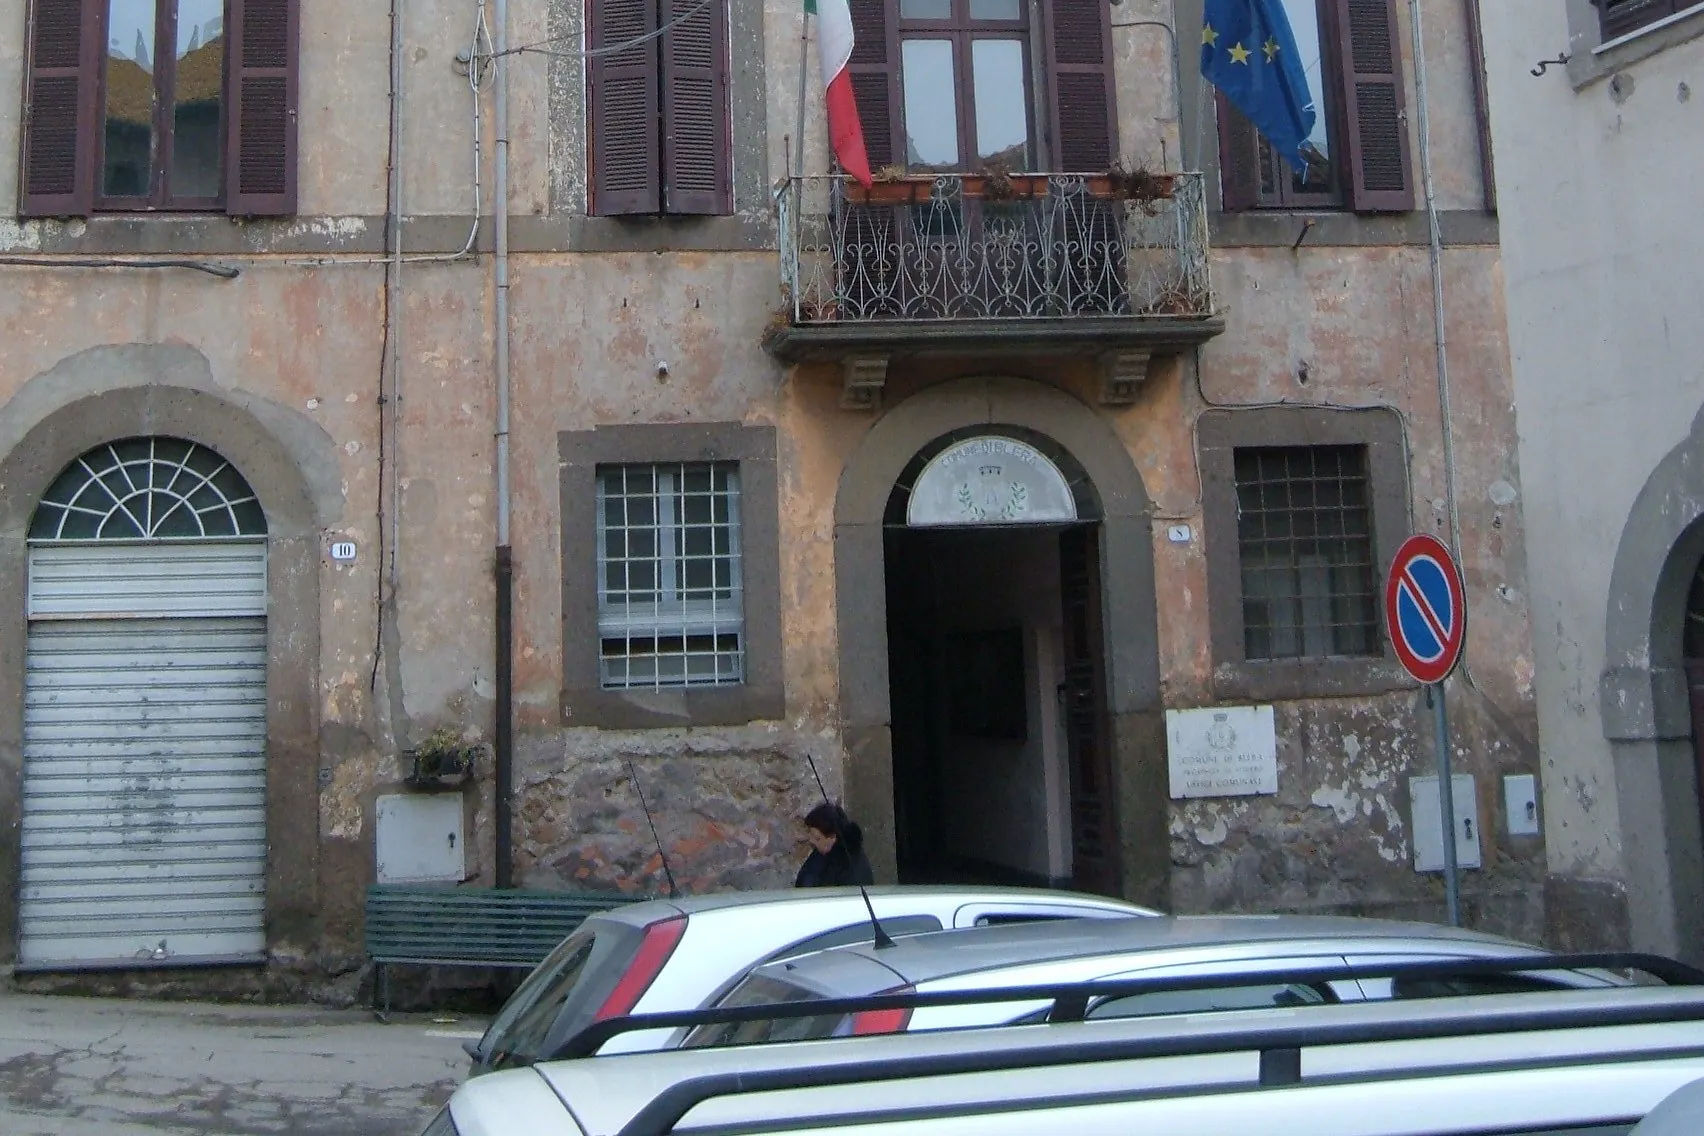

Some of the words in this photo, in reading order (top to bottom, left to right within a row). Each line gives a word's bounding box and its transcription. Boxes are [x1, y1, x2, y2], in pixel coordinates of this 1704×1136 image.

[981, 441, 993, 454] DI
[994, 441, 1038, 466] BLERA
[339, 544, 351, 556] 10
